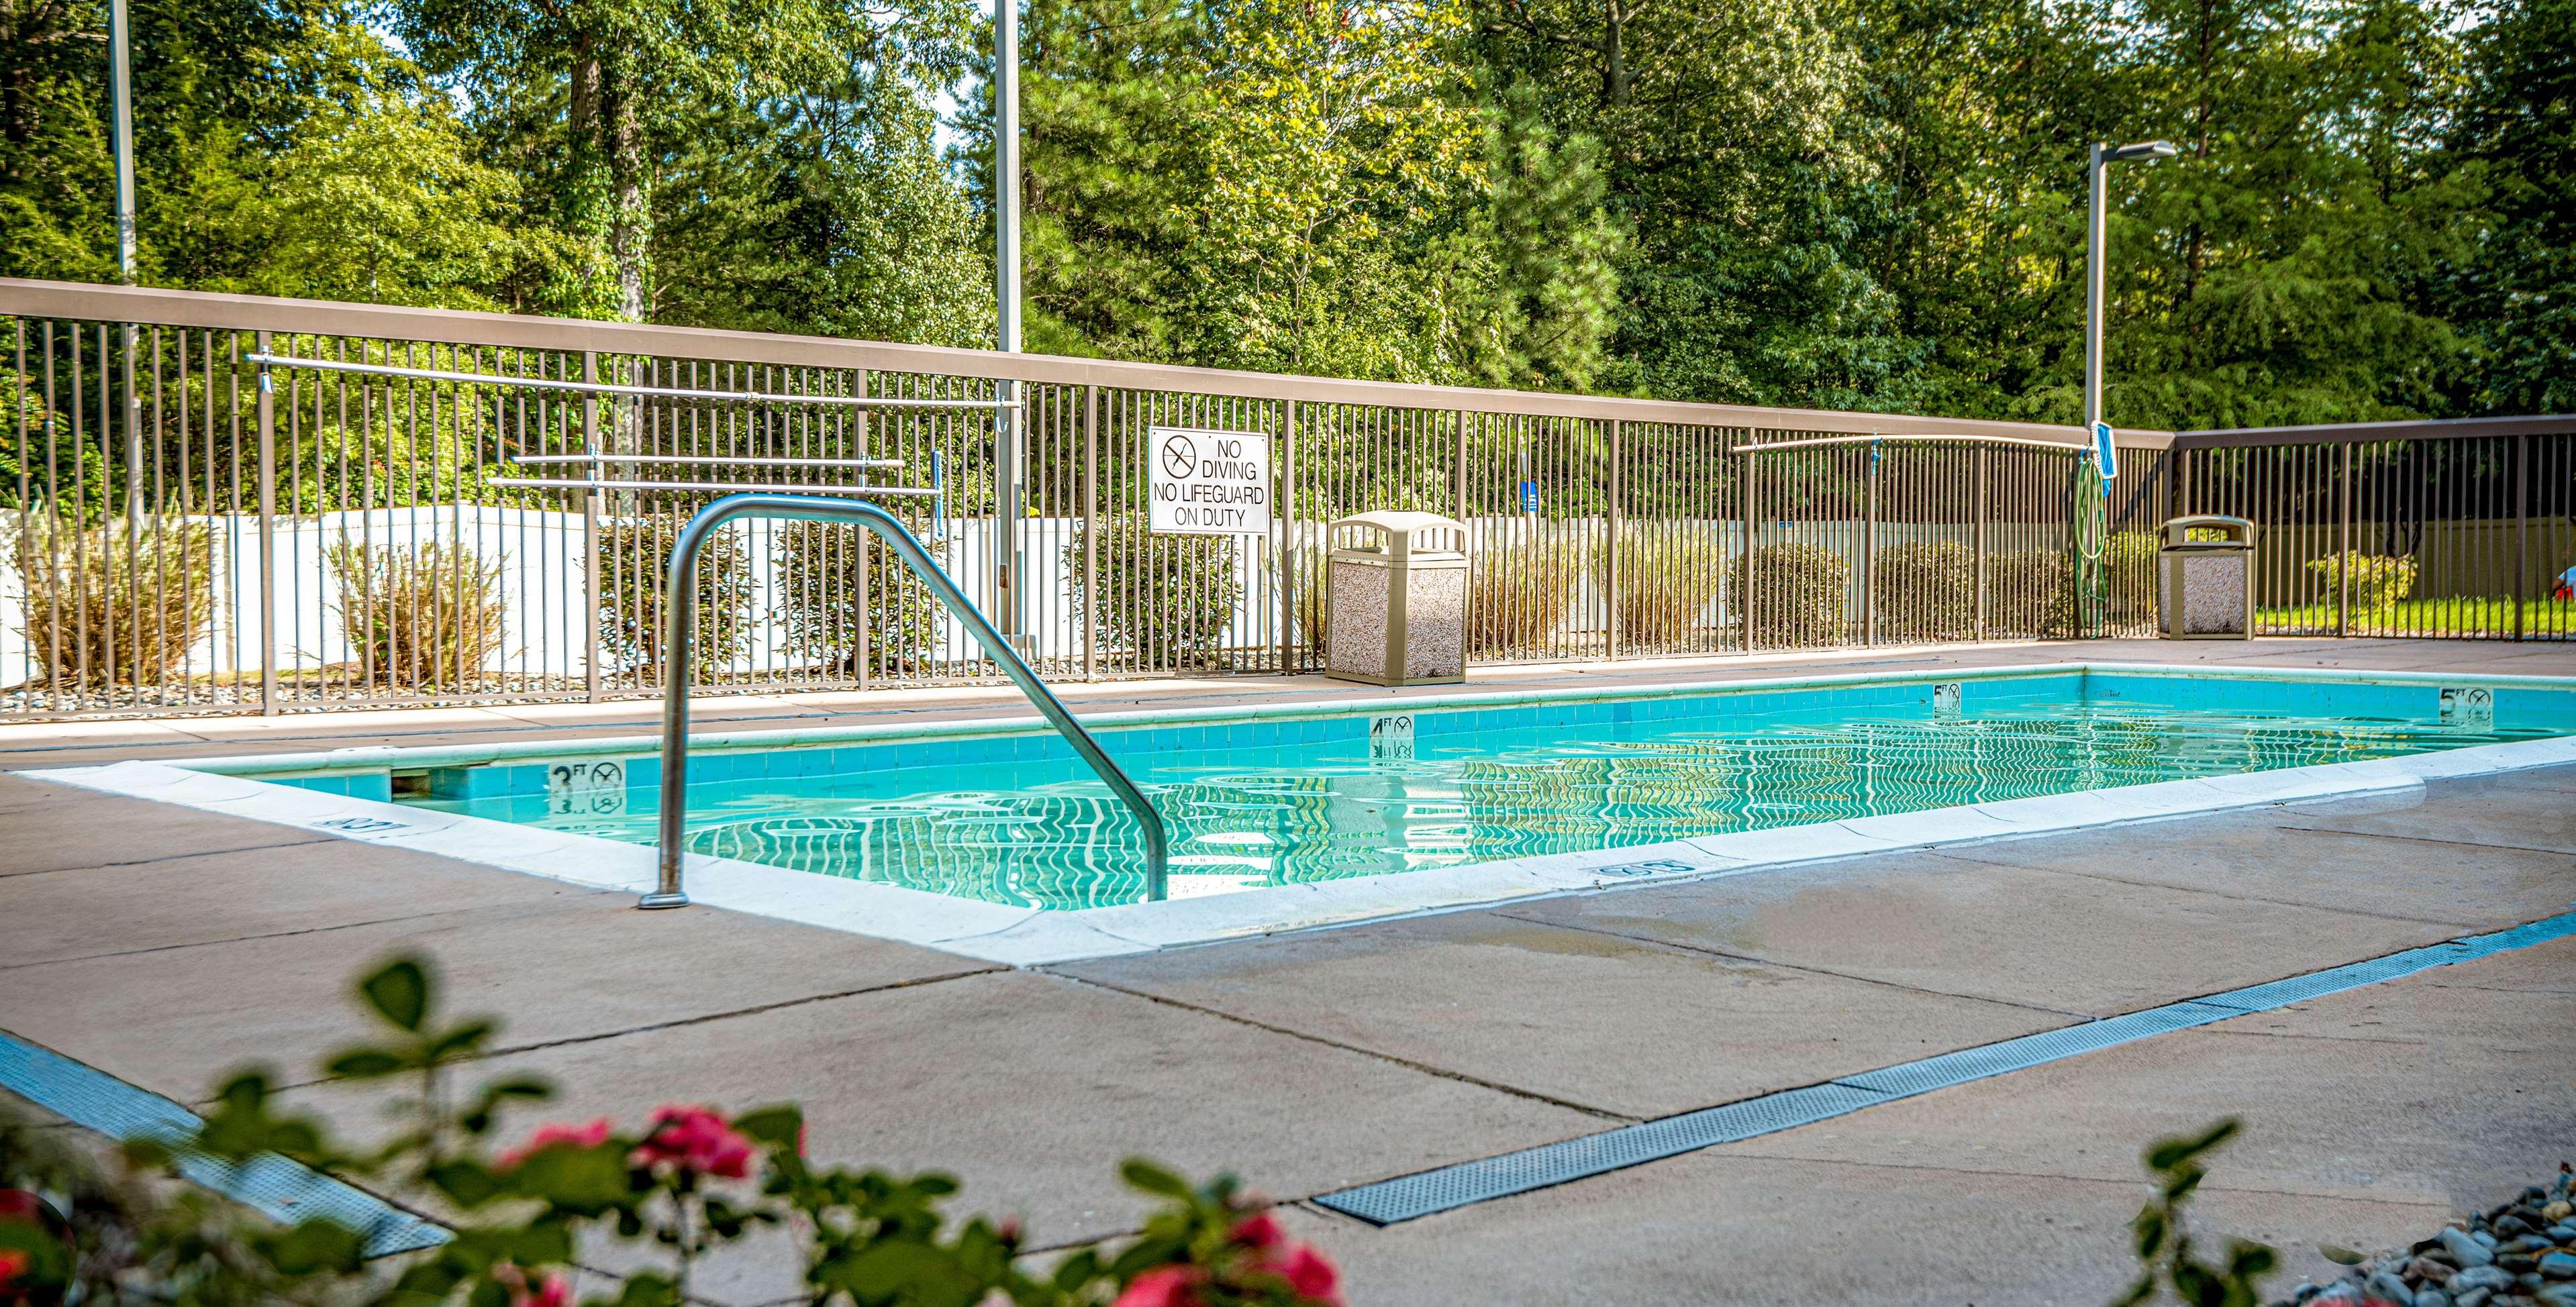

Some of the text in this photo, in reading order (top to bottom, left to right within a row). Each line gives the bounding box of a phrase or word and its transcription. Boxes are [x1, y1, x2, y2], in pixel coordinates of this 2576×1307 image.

[1218, 439, 1242, 458] NO
[1202, 460, 1257, 480] DIVING
[1154, 482, 1265, 505] NO LIFEGUARD
[1175, 507, 1246, 527] ON DUTY
[2456, 688, 2465, 696] FT
[1384, 717, 1392, 727] FT
[574, 764, 587, 776] FT
